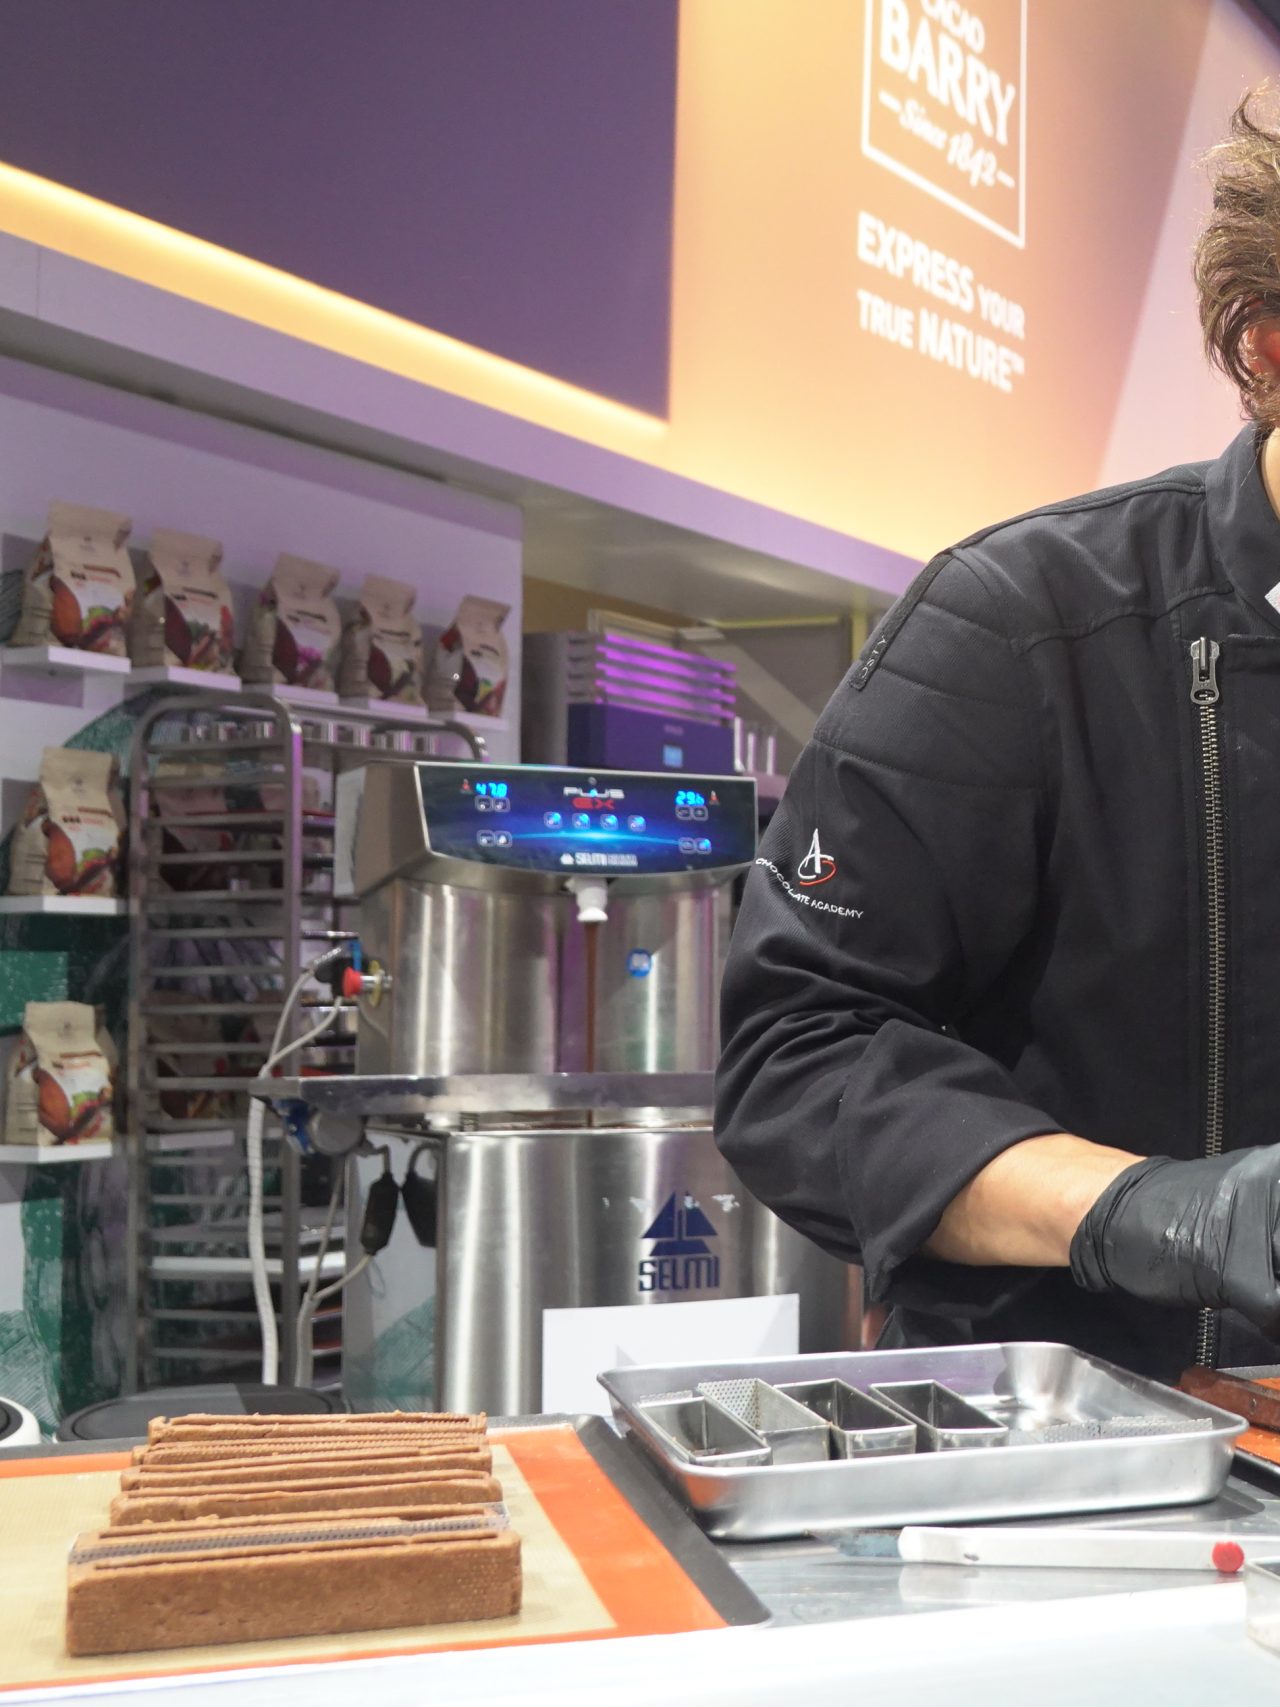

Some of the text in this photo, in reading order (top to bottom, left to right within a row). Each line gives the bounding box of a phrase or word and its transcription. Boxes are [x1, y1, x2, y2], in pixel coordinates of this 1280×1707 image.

[879, 0, 1016, 146] BARRY
[946, 131, 997, 188] 1842
[857, 210, 1025, 340] EXPRESS YOUR
[856, 287, 914, 349] TRUE
[755, 857, 864, 919] CHOCOLATE ACADEMY
[638, 1256, 719, 1292] SELMI
